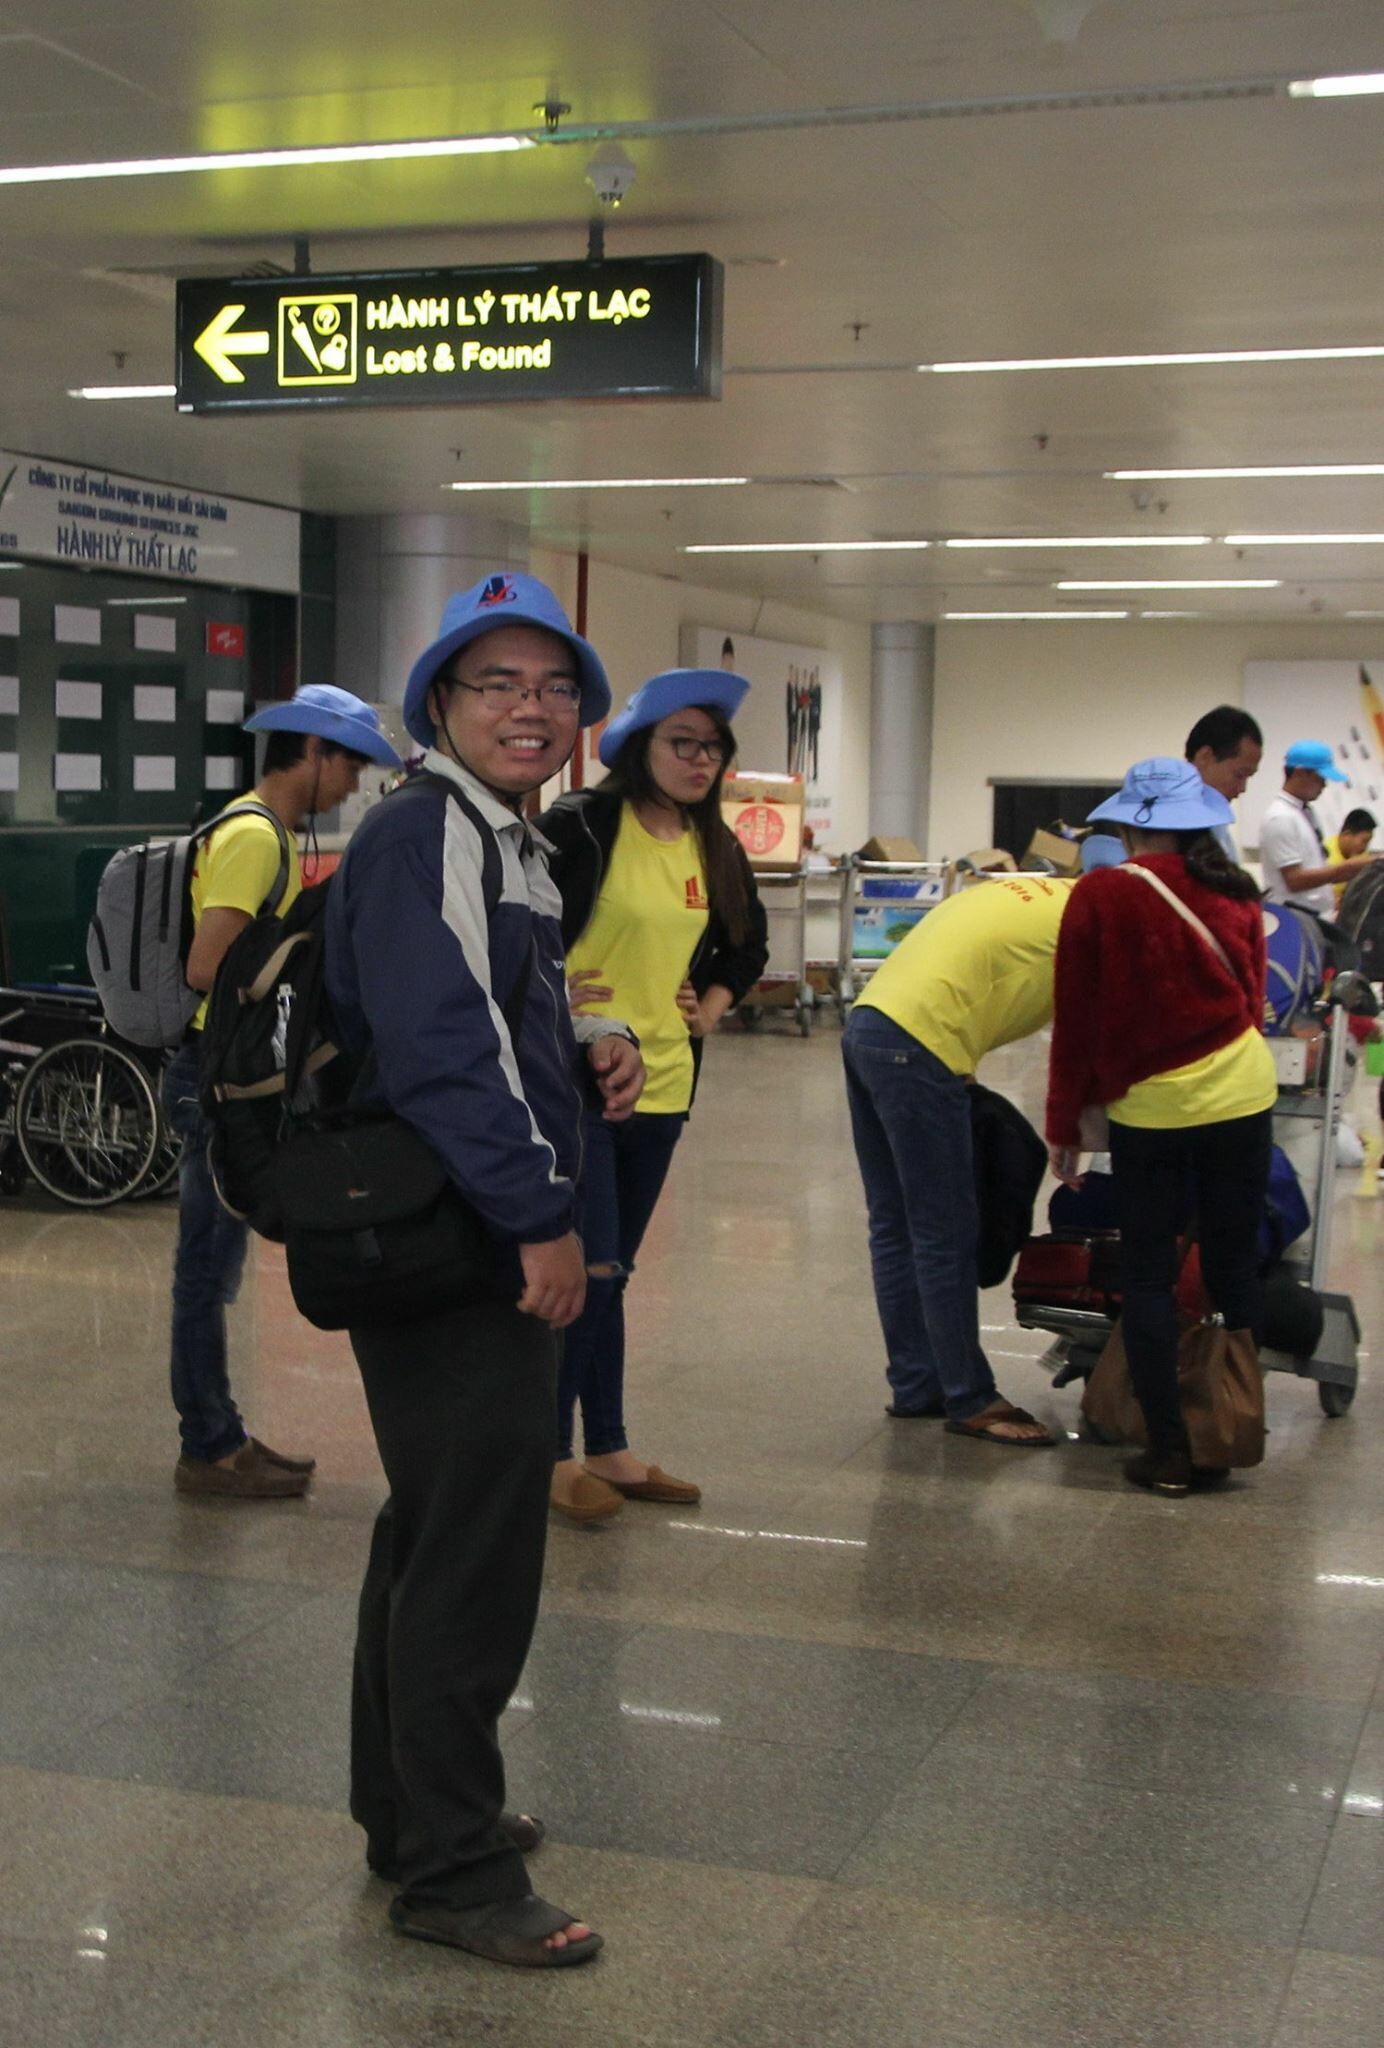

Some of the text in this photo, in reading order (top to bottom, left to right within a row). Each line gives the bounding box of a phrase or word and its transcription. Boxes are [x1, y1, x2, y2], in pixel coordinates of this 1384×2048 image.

[367, 294, 449, 331] HÀNH
[457, 290, 496, 326] LÝ
[589, 288, 650, 325] LẠC
[366, 338, 551, 375] Lost & Found
[57, 520, 102, 559] HÀNH
[105, 529, 122, 561] LÝ
[168, 545, 197, 575] LẠC
